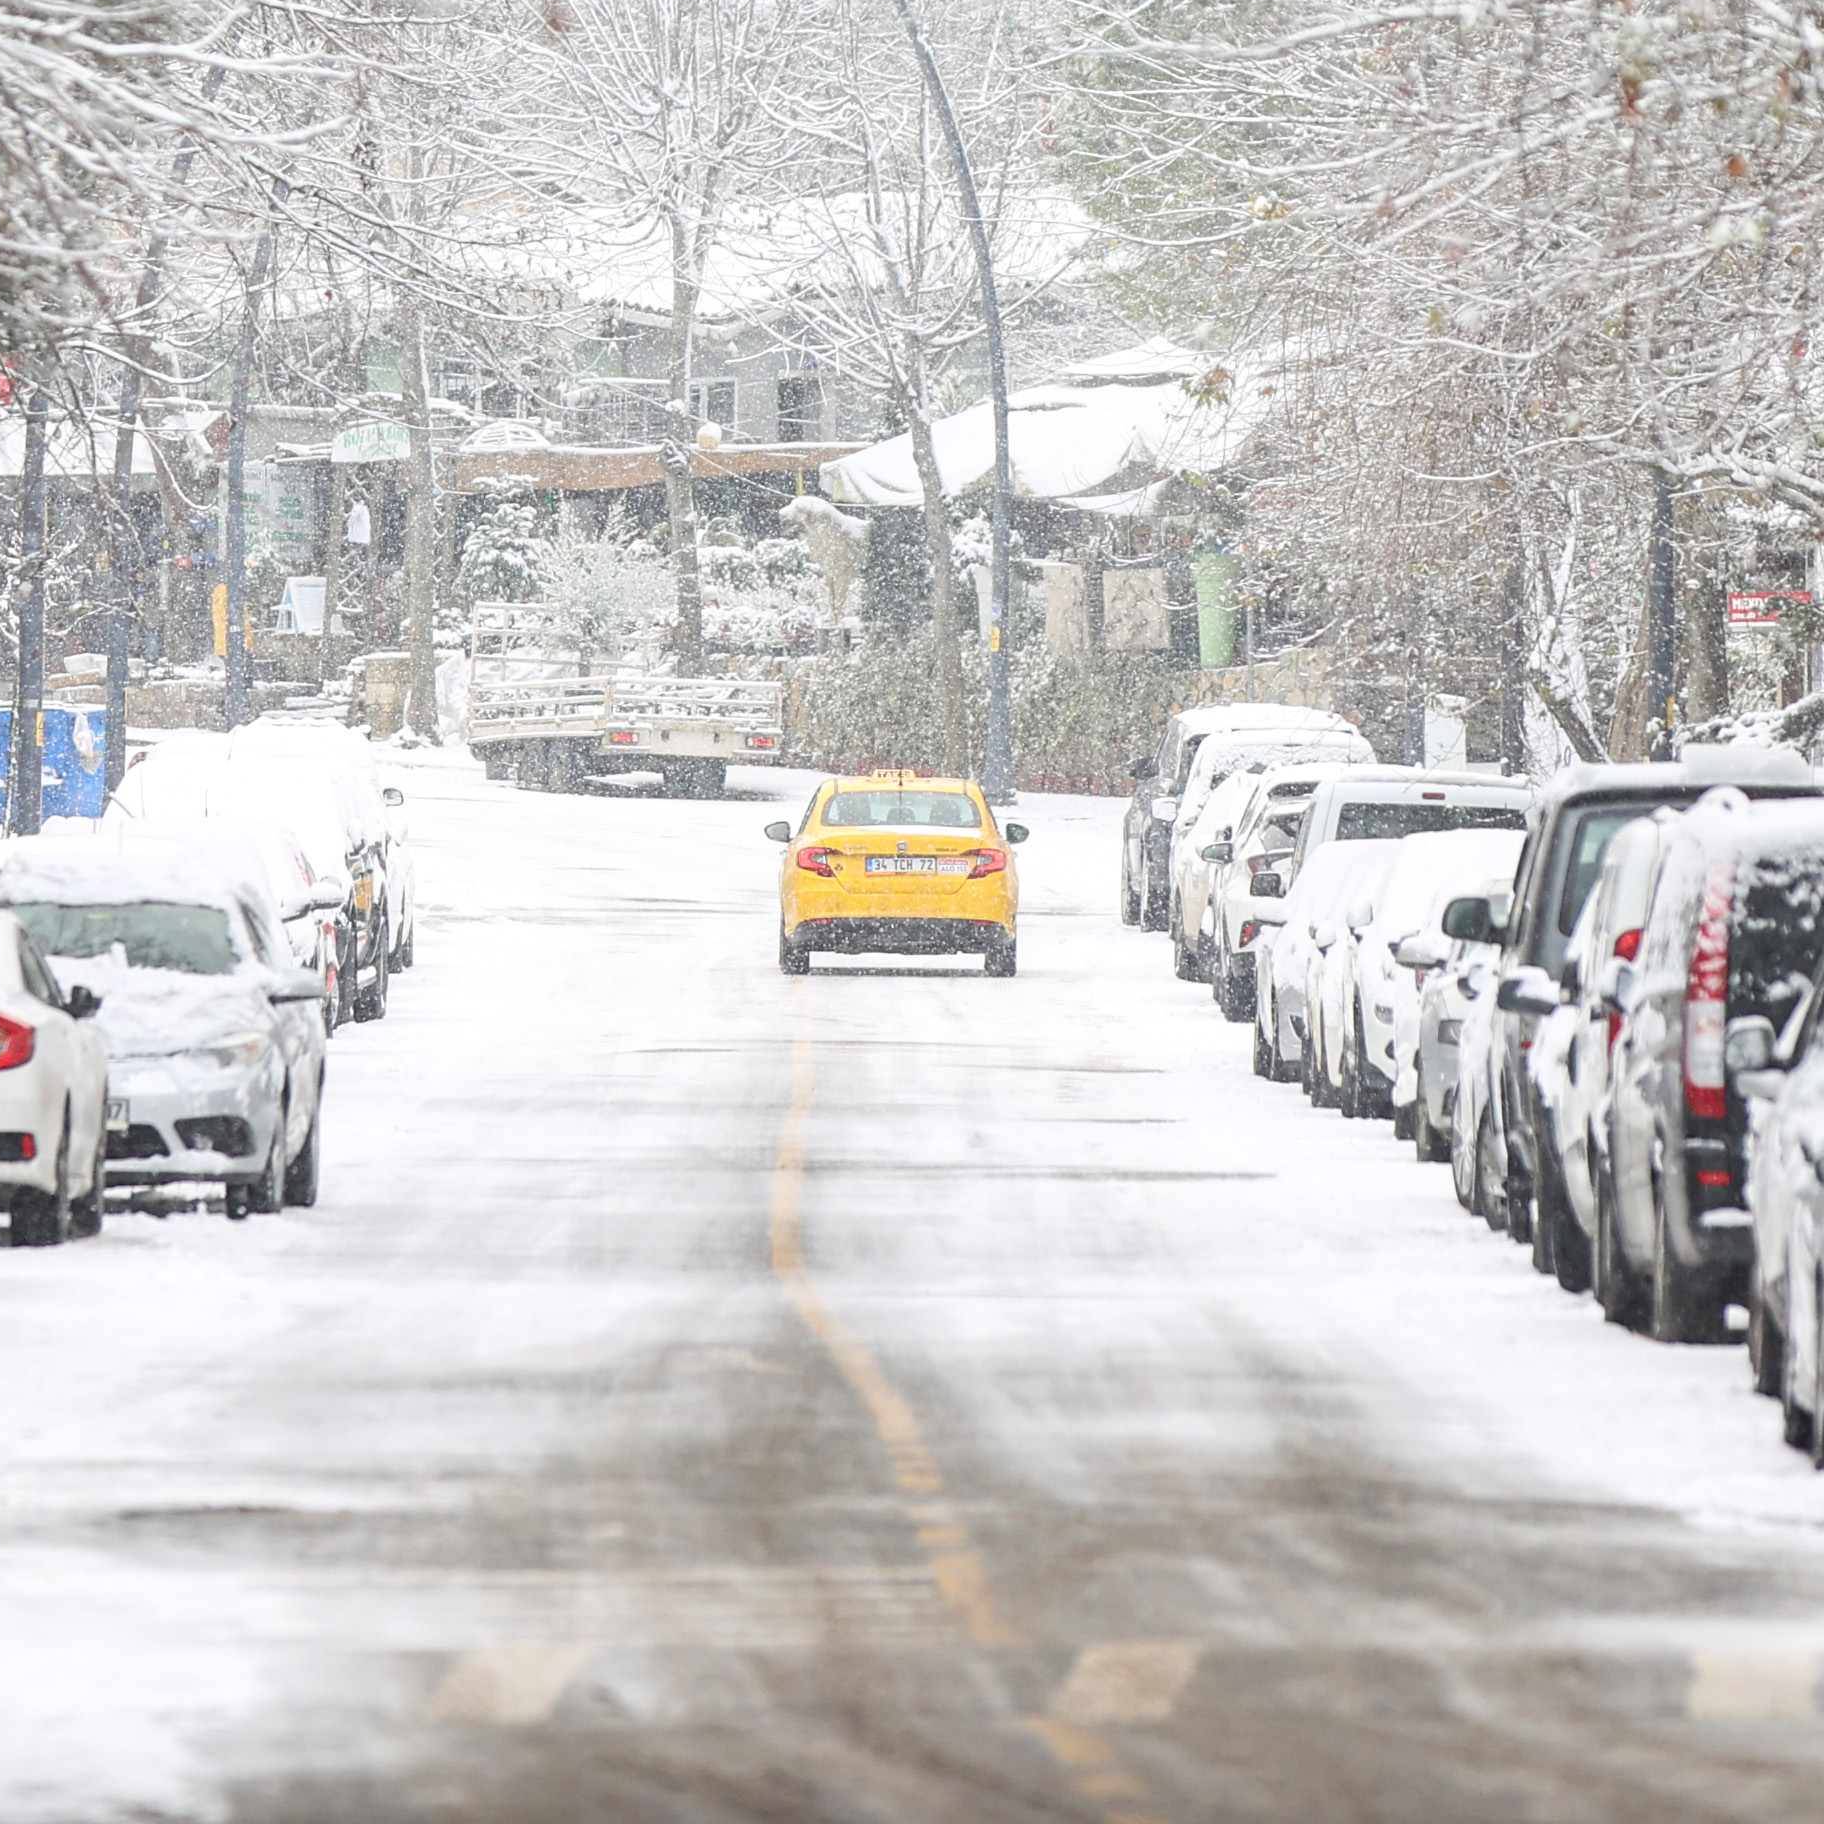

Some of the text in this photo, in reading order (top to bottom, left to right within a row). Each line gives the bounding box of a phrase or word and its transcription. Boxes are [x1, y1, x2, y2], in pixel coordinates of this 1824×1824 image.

[874, 859, 887, 870] 34
[893, 859, 913, 870] TCH
[920, 859, 933, 870] 72
